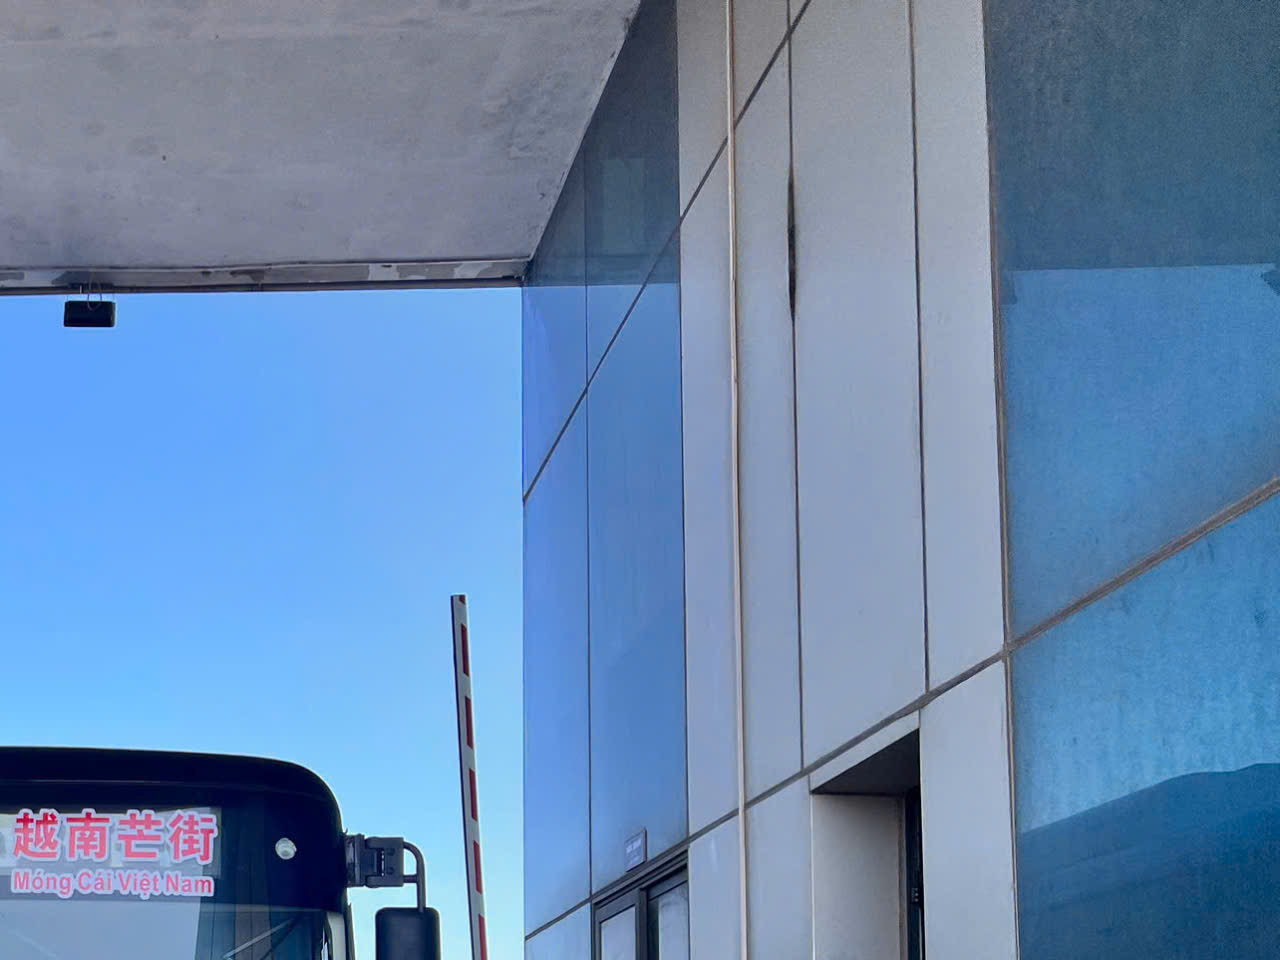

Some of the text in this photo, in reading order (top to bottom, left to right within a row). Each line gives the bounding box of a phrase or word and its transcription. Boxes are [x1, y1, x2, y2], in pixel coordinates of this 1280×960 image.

[13, 810, 216, 862] 越南芒街
[14, 871, 213, 896] Móng Cái Việt Nam
